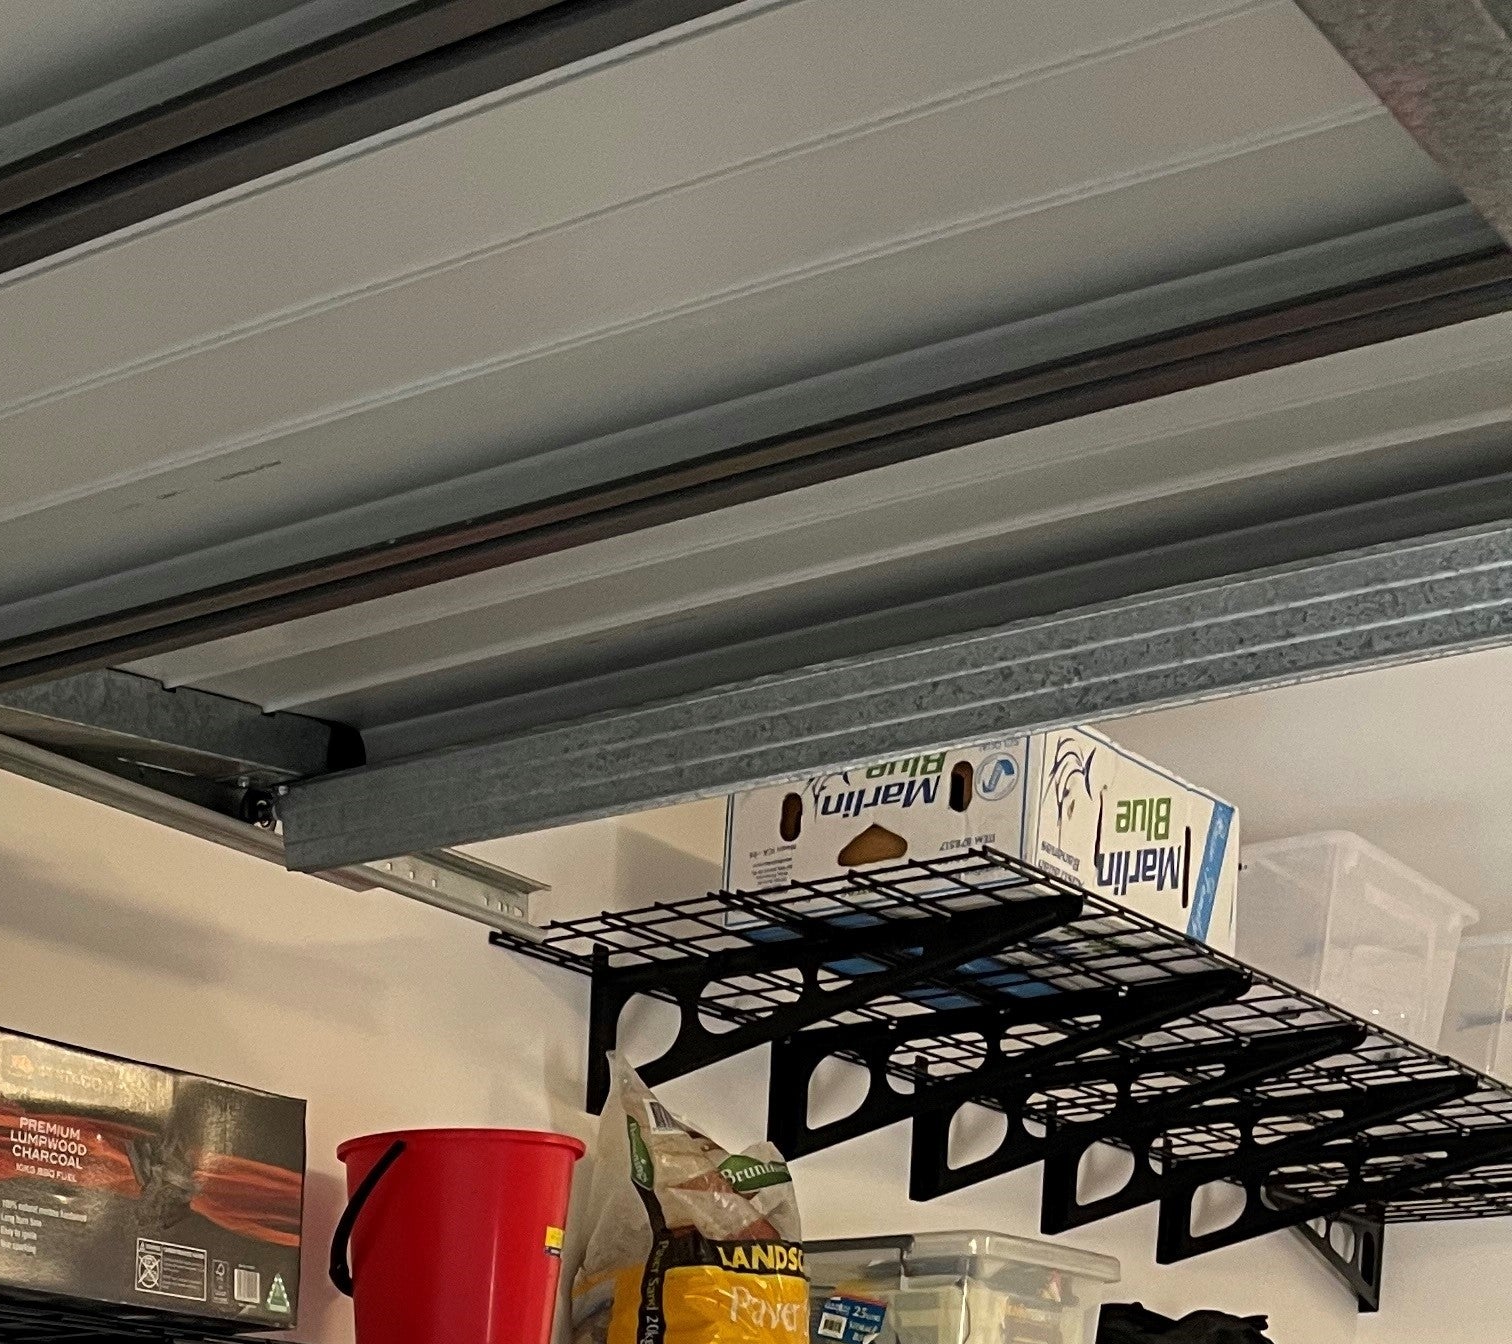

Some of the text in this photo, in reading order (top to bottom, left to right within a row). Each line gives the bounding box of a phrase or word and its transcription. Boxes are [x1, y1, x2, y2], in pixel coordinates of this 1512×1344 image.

[821, 775, 941, 818] Marlin
[1115, 797, 1171, 842] Blue
[1097, 845, 1181, 896] Marlin
[10, 1129, 88, 1156] LUMPWOOD
[20, 1116, 81, 1141] PREMIUM
[12, 1144, 83, 1170] CHARCOAL
[56, 1170, 78, 1182] FUEL
[645, 1277, 660, 1311] Sand
